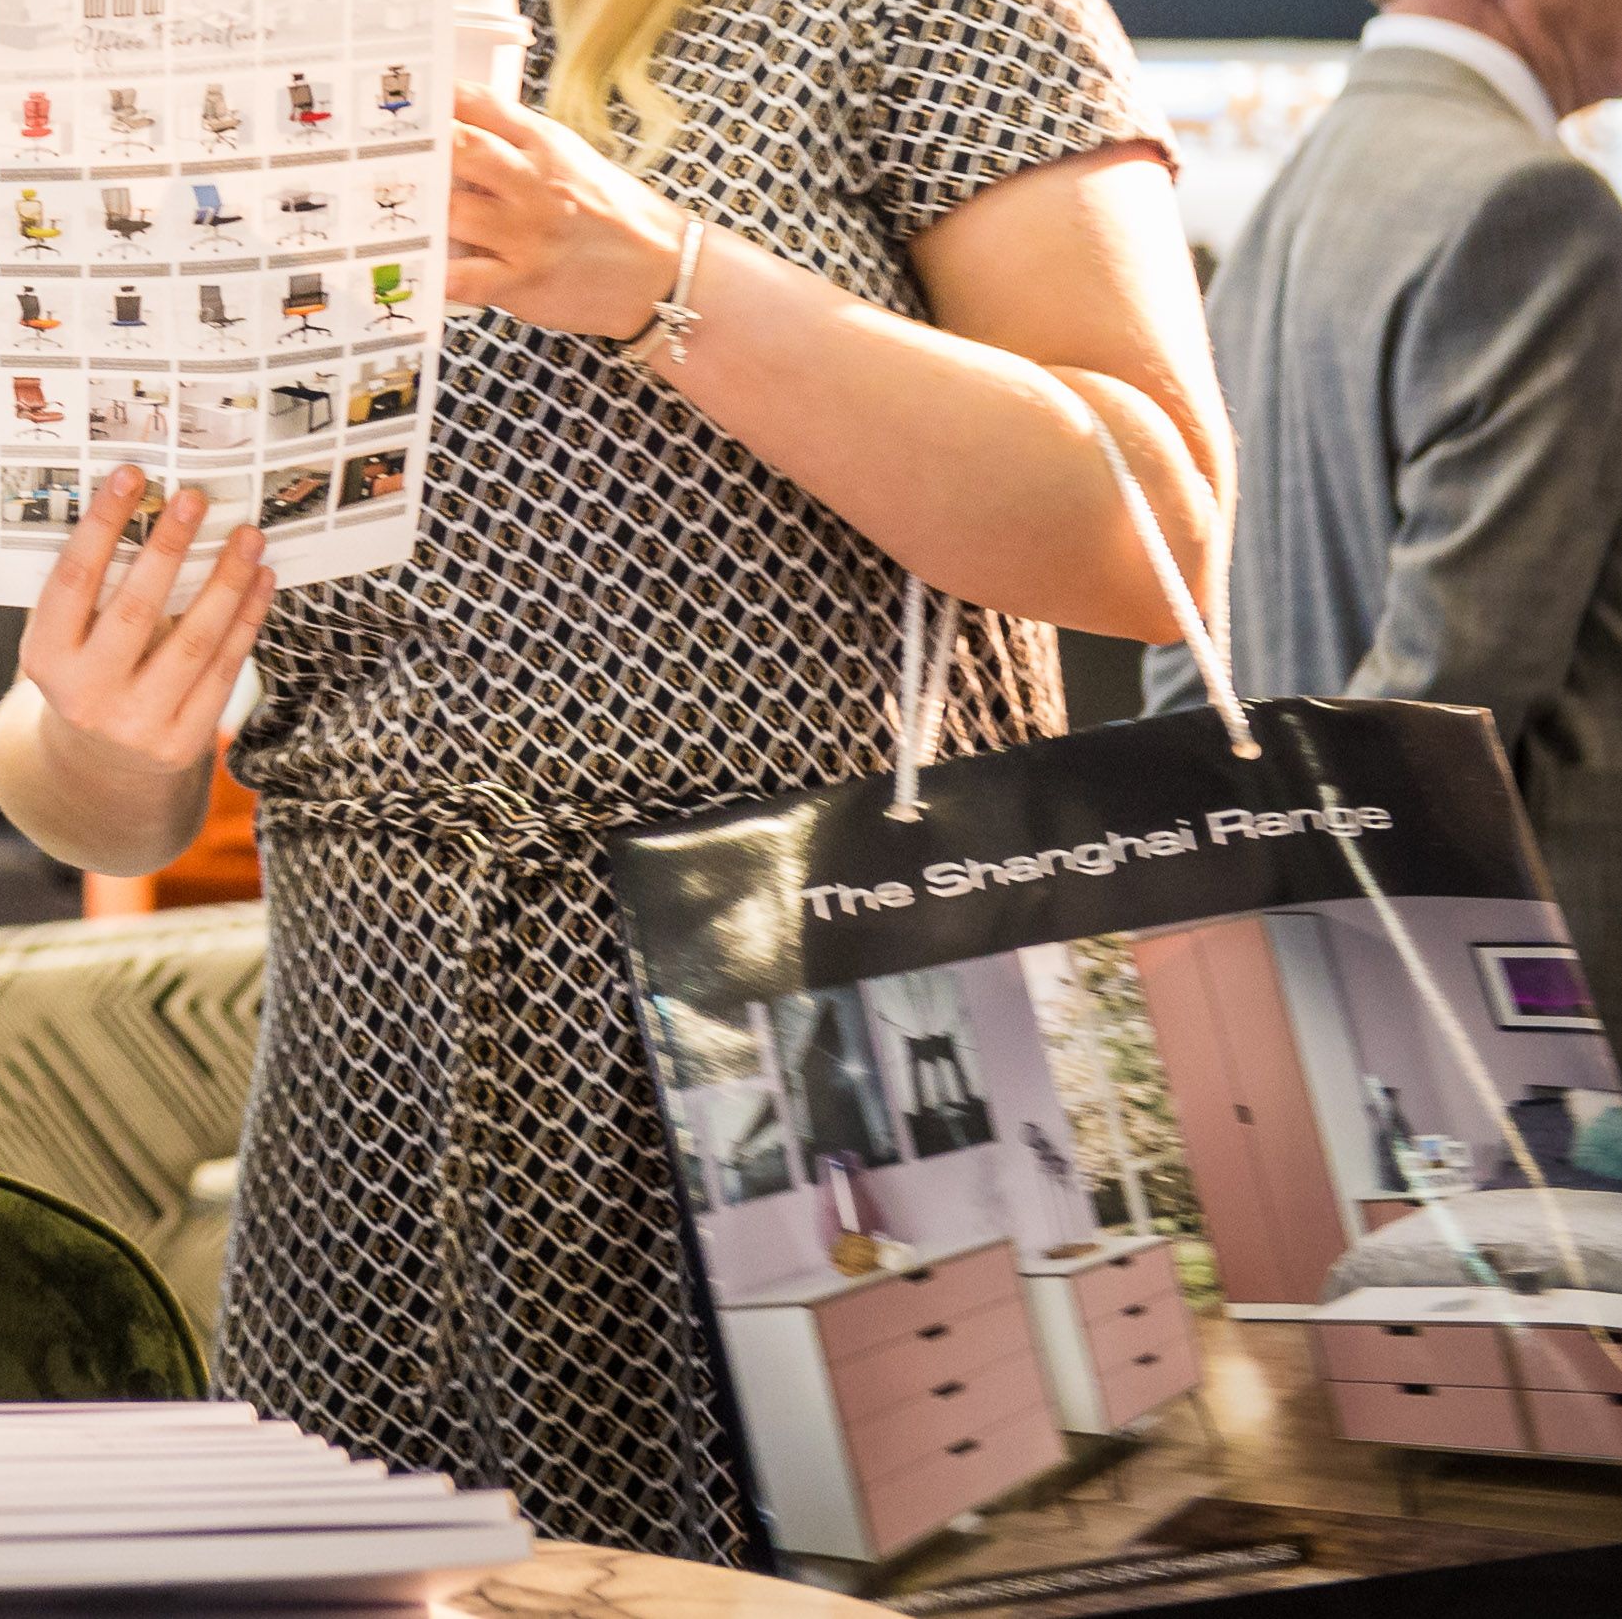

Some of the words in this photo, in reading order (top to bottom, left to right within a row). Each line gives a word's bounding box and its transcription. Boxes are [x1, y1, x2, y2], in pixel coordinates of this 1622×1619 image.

[801, 880, 916, 922] The
[921, 818, 1198, 899] Shanghai
[1204, 805, 1394, 846] Range
